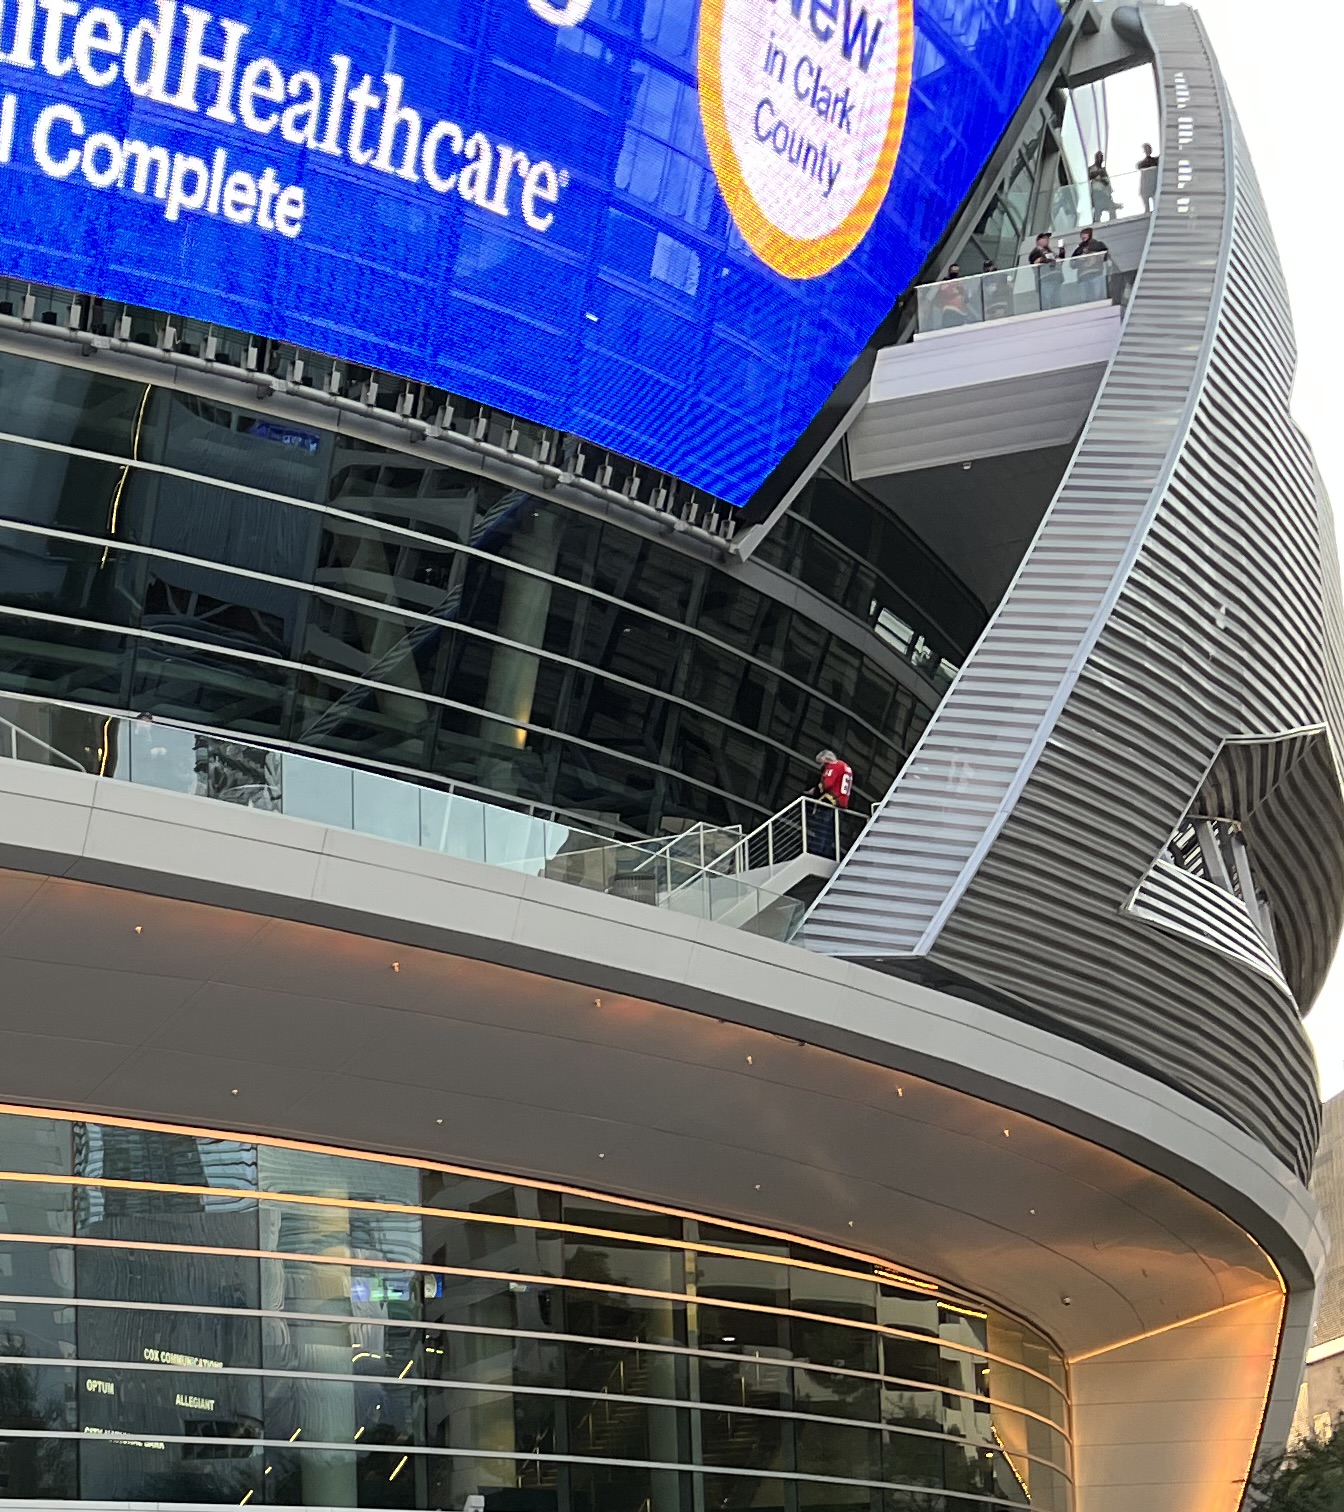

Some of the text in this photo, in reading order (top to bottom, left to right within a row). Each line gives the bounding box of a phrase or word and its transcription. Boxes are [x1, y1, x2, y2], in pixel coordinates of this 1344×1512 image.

[788, 0, 883, 72] ew
[763, 31, 856, 134] in Clark
[31, 103, 306, 238] Complete
[754, 97, 842, 198] County
[86, 1378, 115, 1396] OPTUM
[175, 1393, 215, 1412] ALLEGIANT
